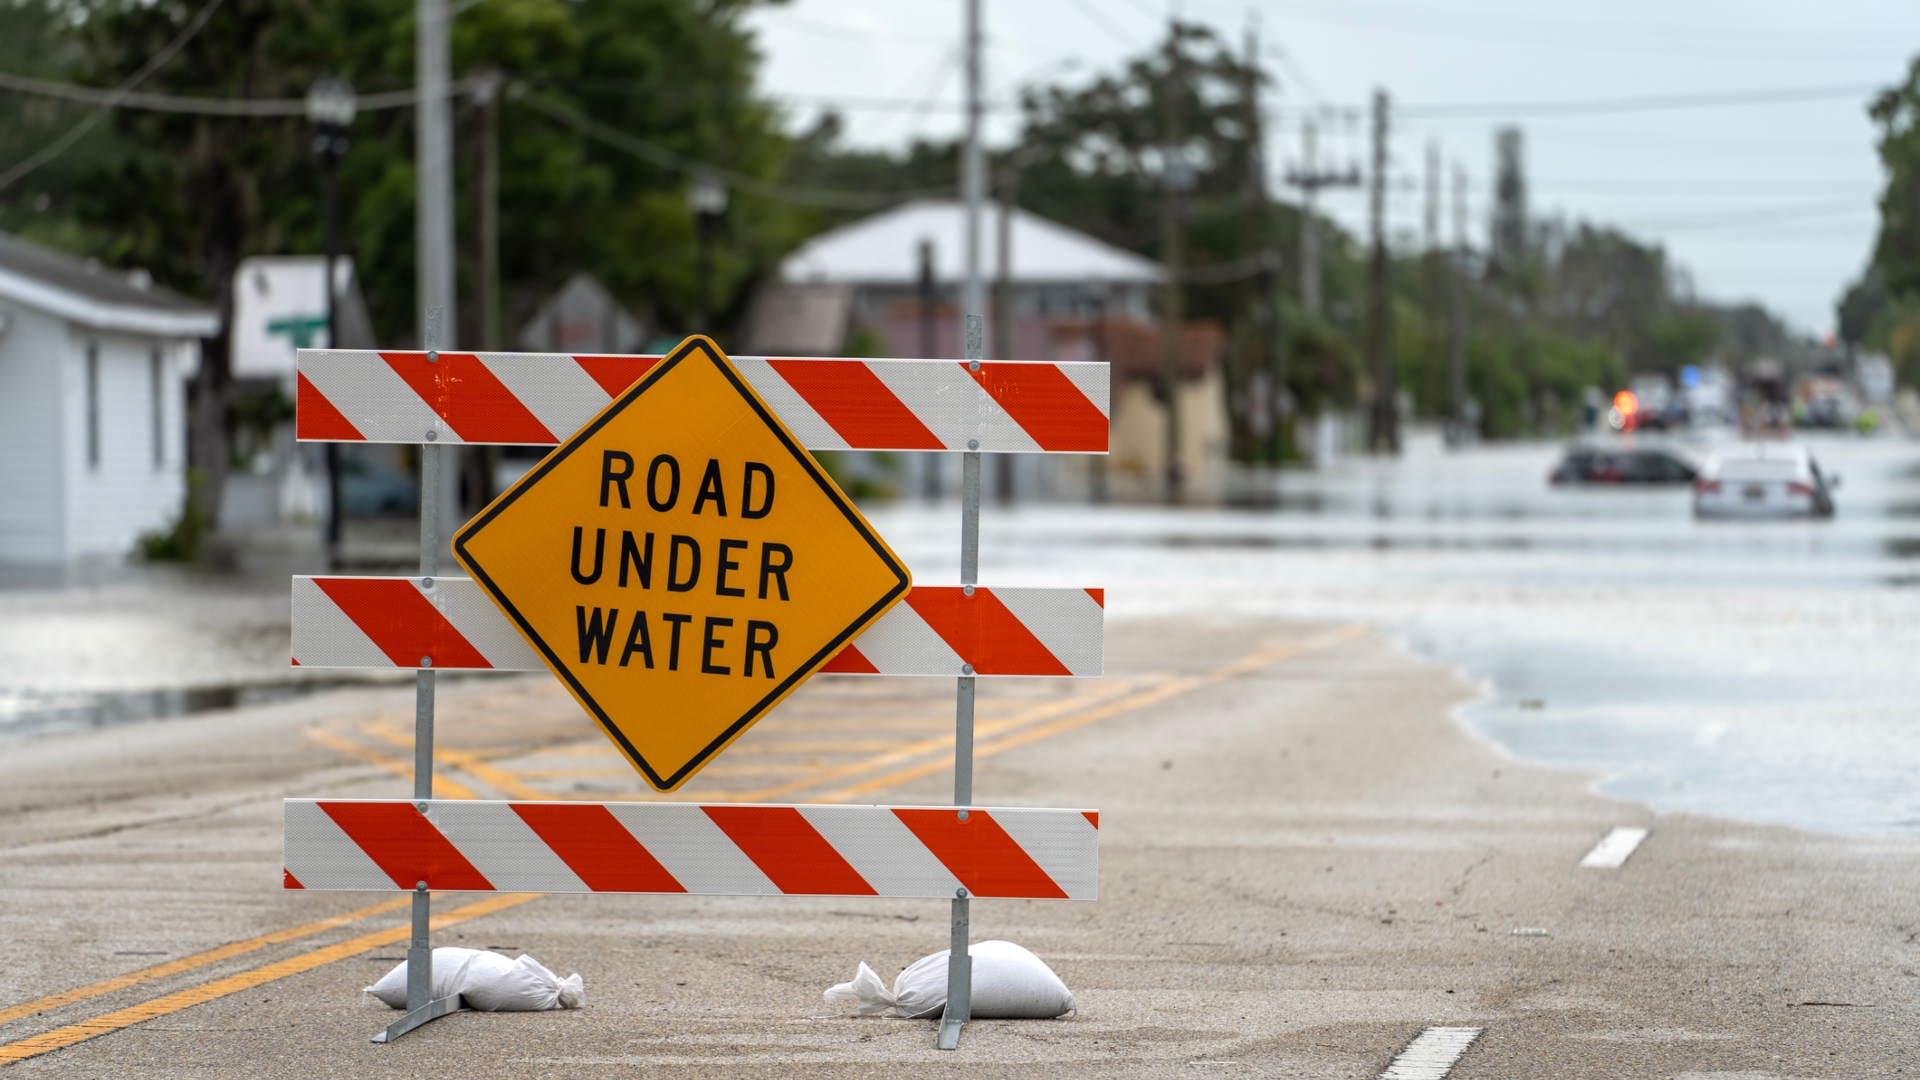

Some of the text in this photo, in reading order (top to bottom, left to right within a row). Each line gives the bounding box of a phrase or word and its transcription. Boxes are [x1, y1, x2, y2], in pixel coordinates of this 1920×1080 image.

[599, 449, 775, 520] ROAD
[570, 526, 794, 602] UNDER
[575, 605, 779, 679] WATER
